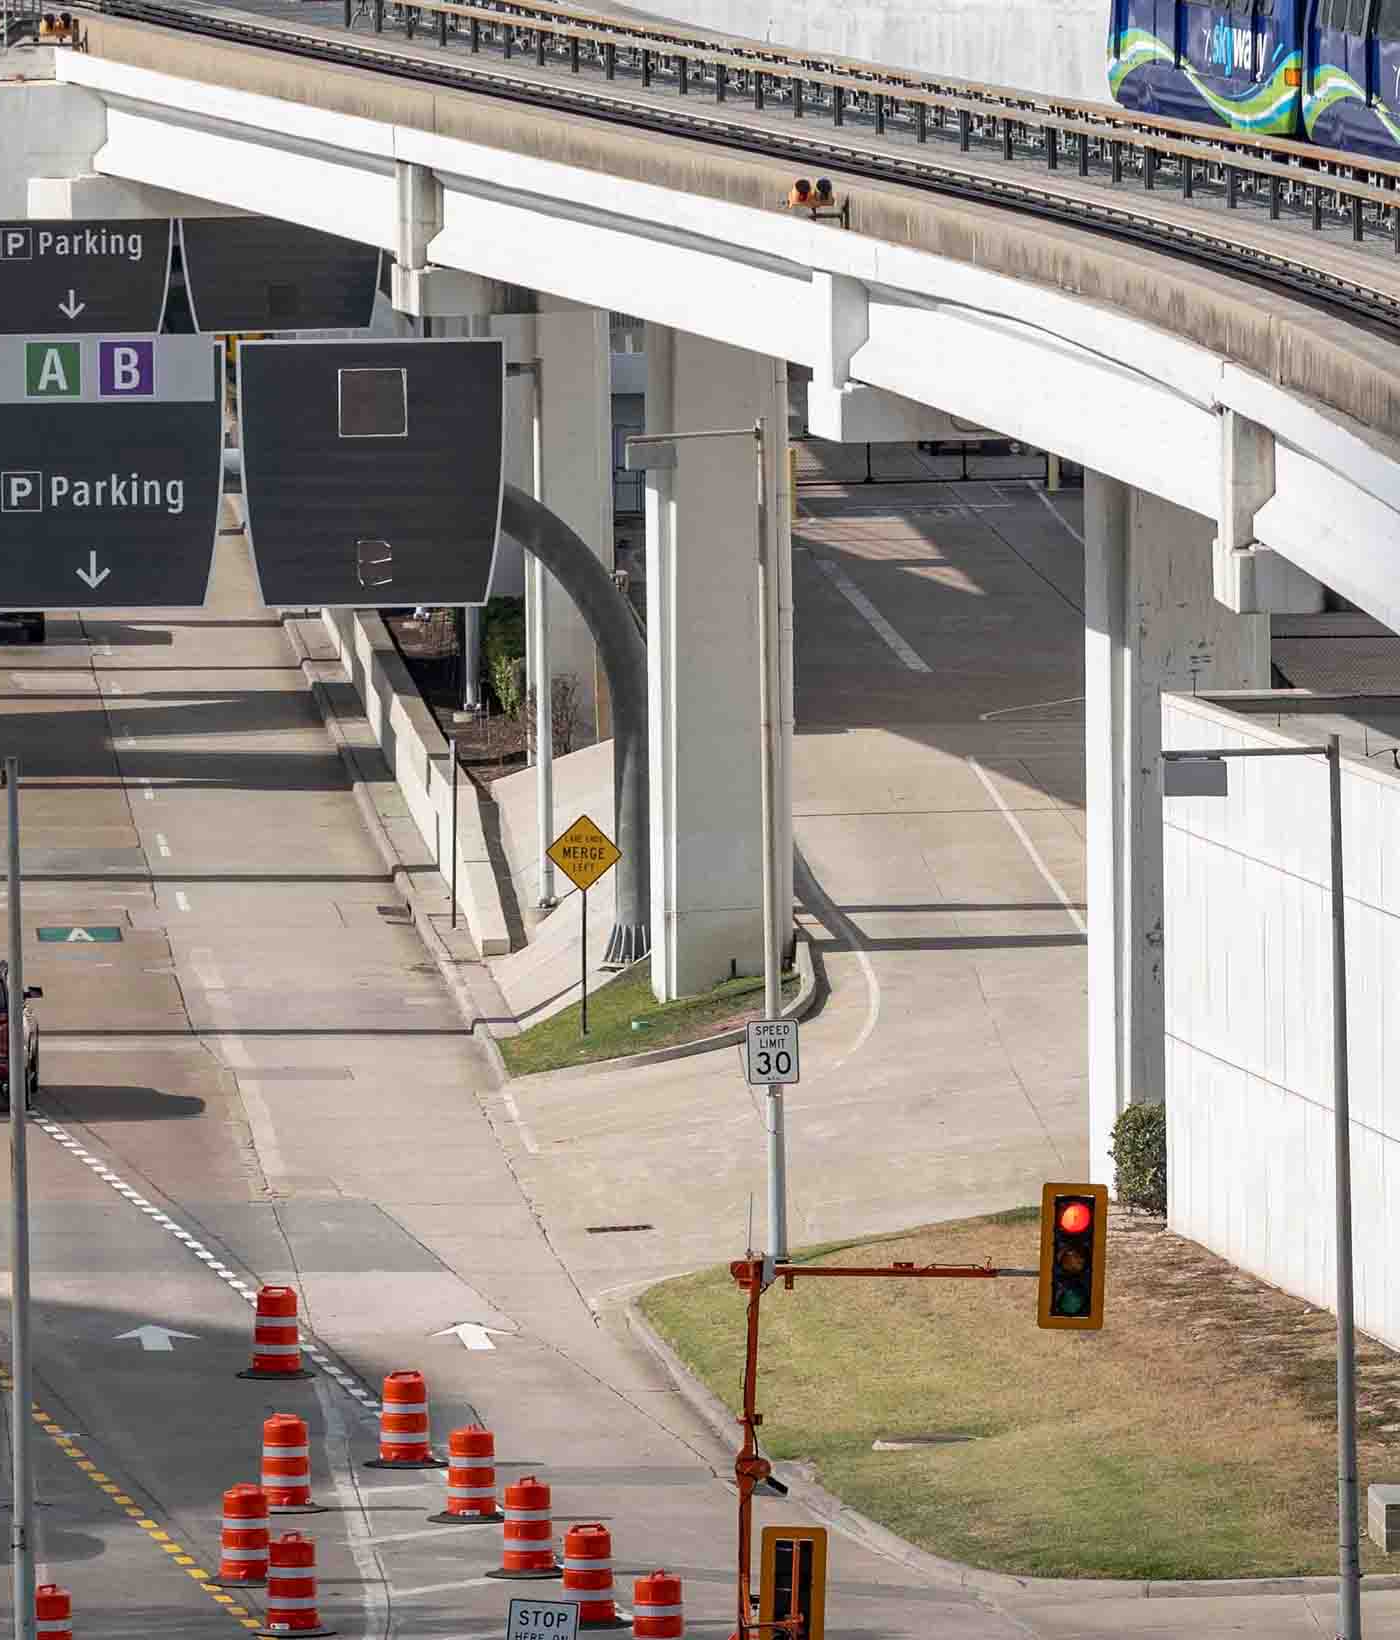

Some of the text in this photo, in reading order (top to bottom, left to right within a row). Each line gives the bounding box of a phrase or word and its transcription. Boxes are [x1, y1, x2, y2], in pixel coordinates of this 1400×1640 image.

[39, 228, 143, 261] Parking
[38, 347, 140, 392] A B
[51, 472, 185, 513] Parking
[563, 848, 605, 860] MERGE
[65, 927, 95, 941] A
[755, 1025, 790, 1036] SPEED
[760, 1038, 786, 1049] LIMIT
[756, 1051, 792, 1075] 30
[519, 1609, 568, 1628] STOP
